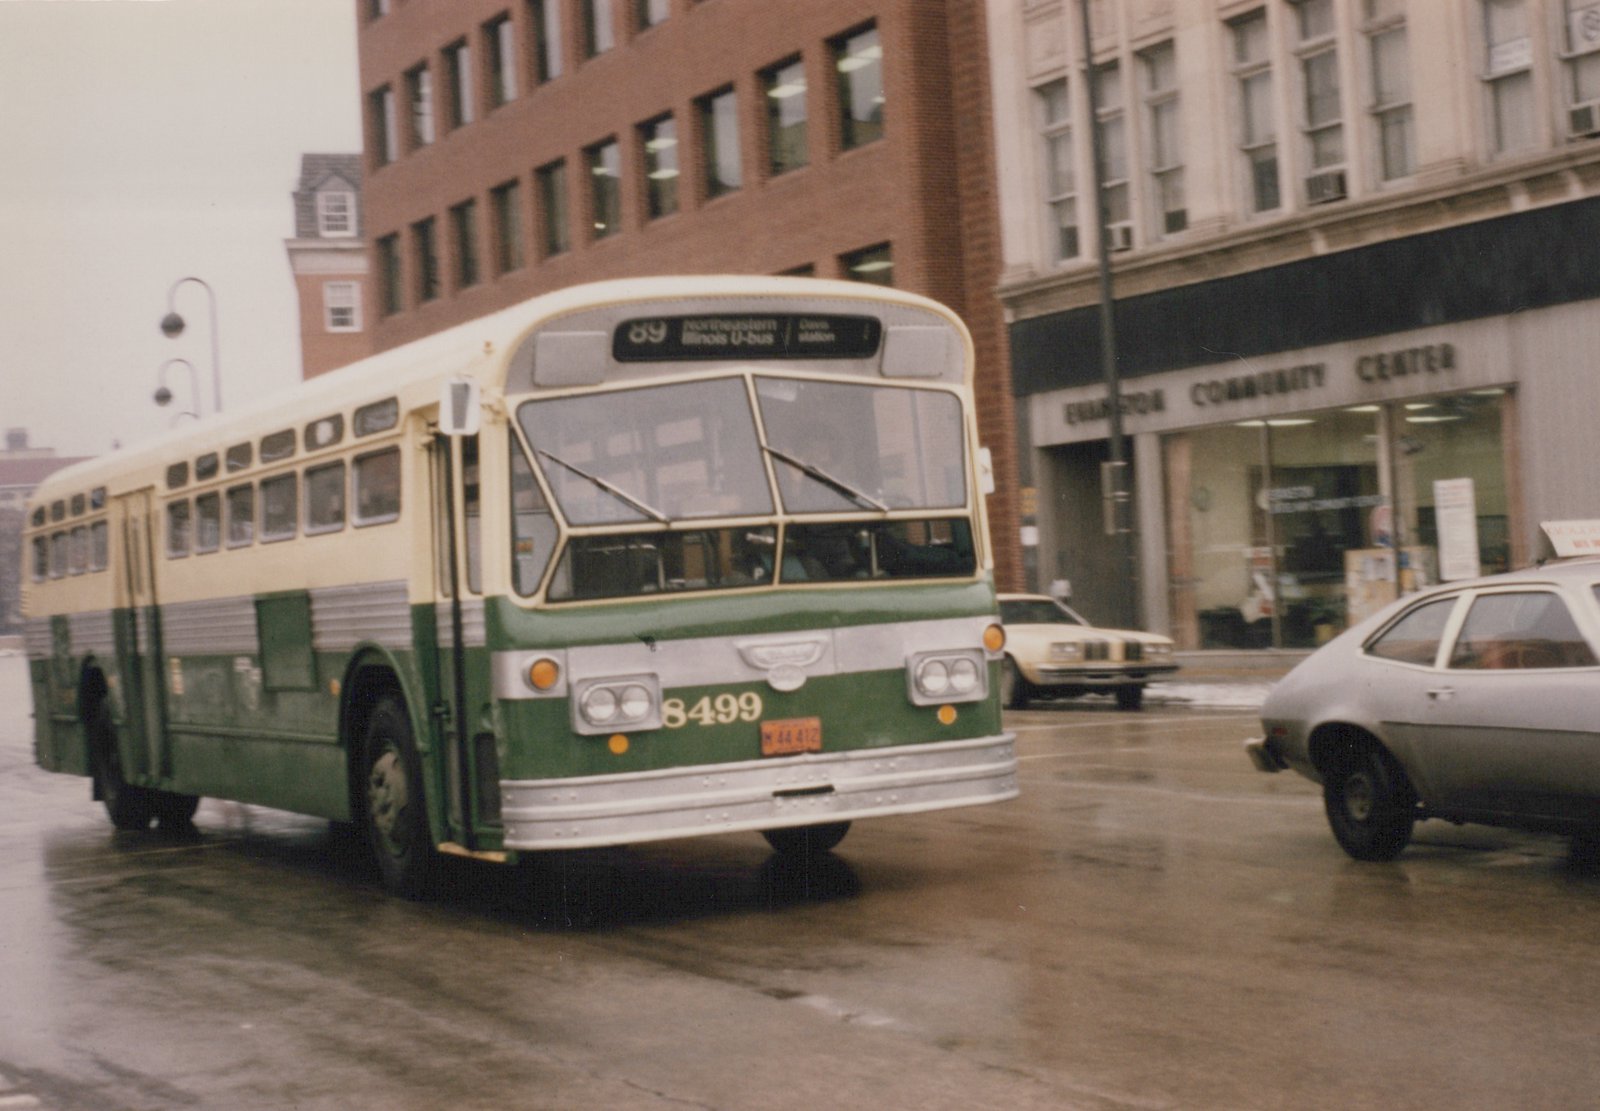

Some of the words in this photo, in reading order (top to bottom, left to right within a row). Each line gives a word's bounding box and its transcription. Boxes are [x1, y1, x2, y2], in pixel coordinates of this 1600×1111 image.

[629, 320, 668, 344] 89
[1190, 362, 1325, 406] COMMUNITY
[1355, 343, 1456, 383] CENTER
[662, 692, 762, 728] 8499
